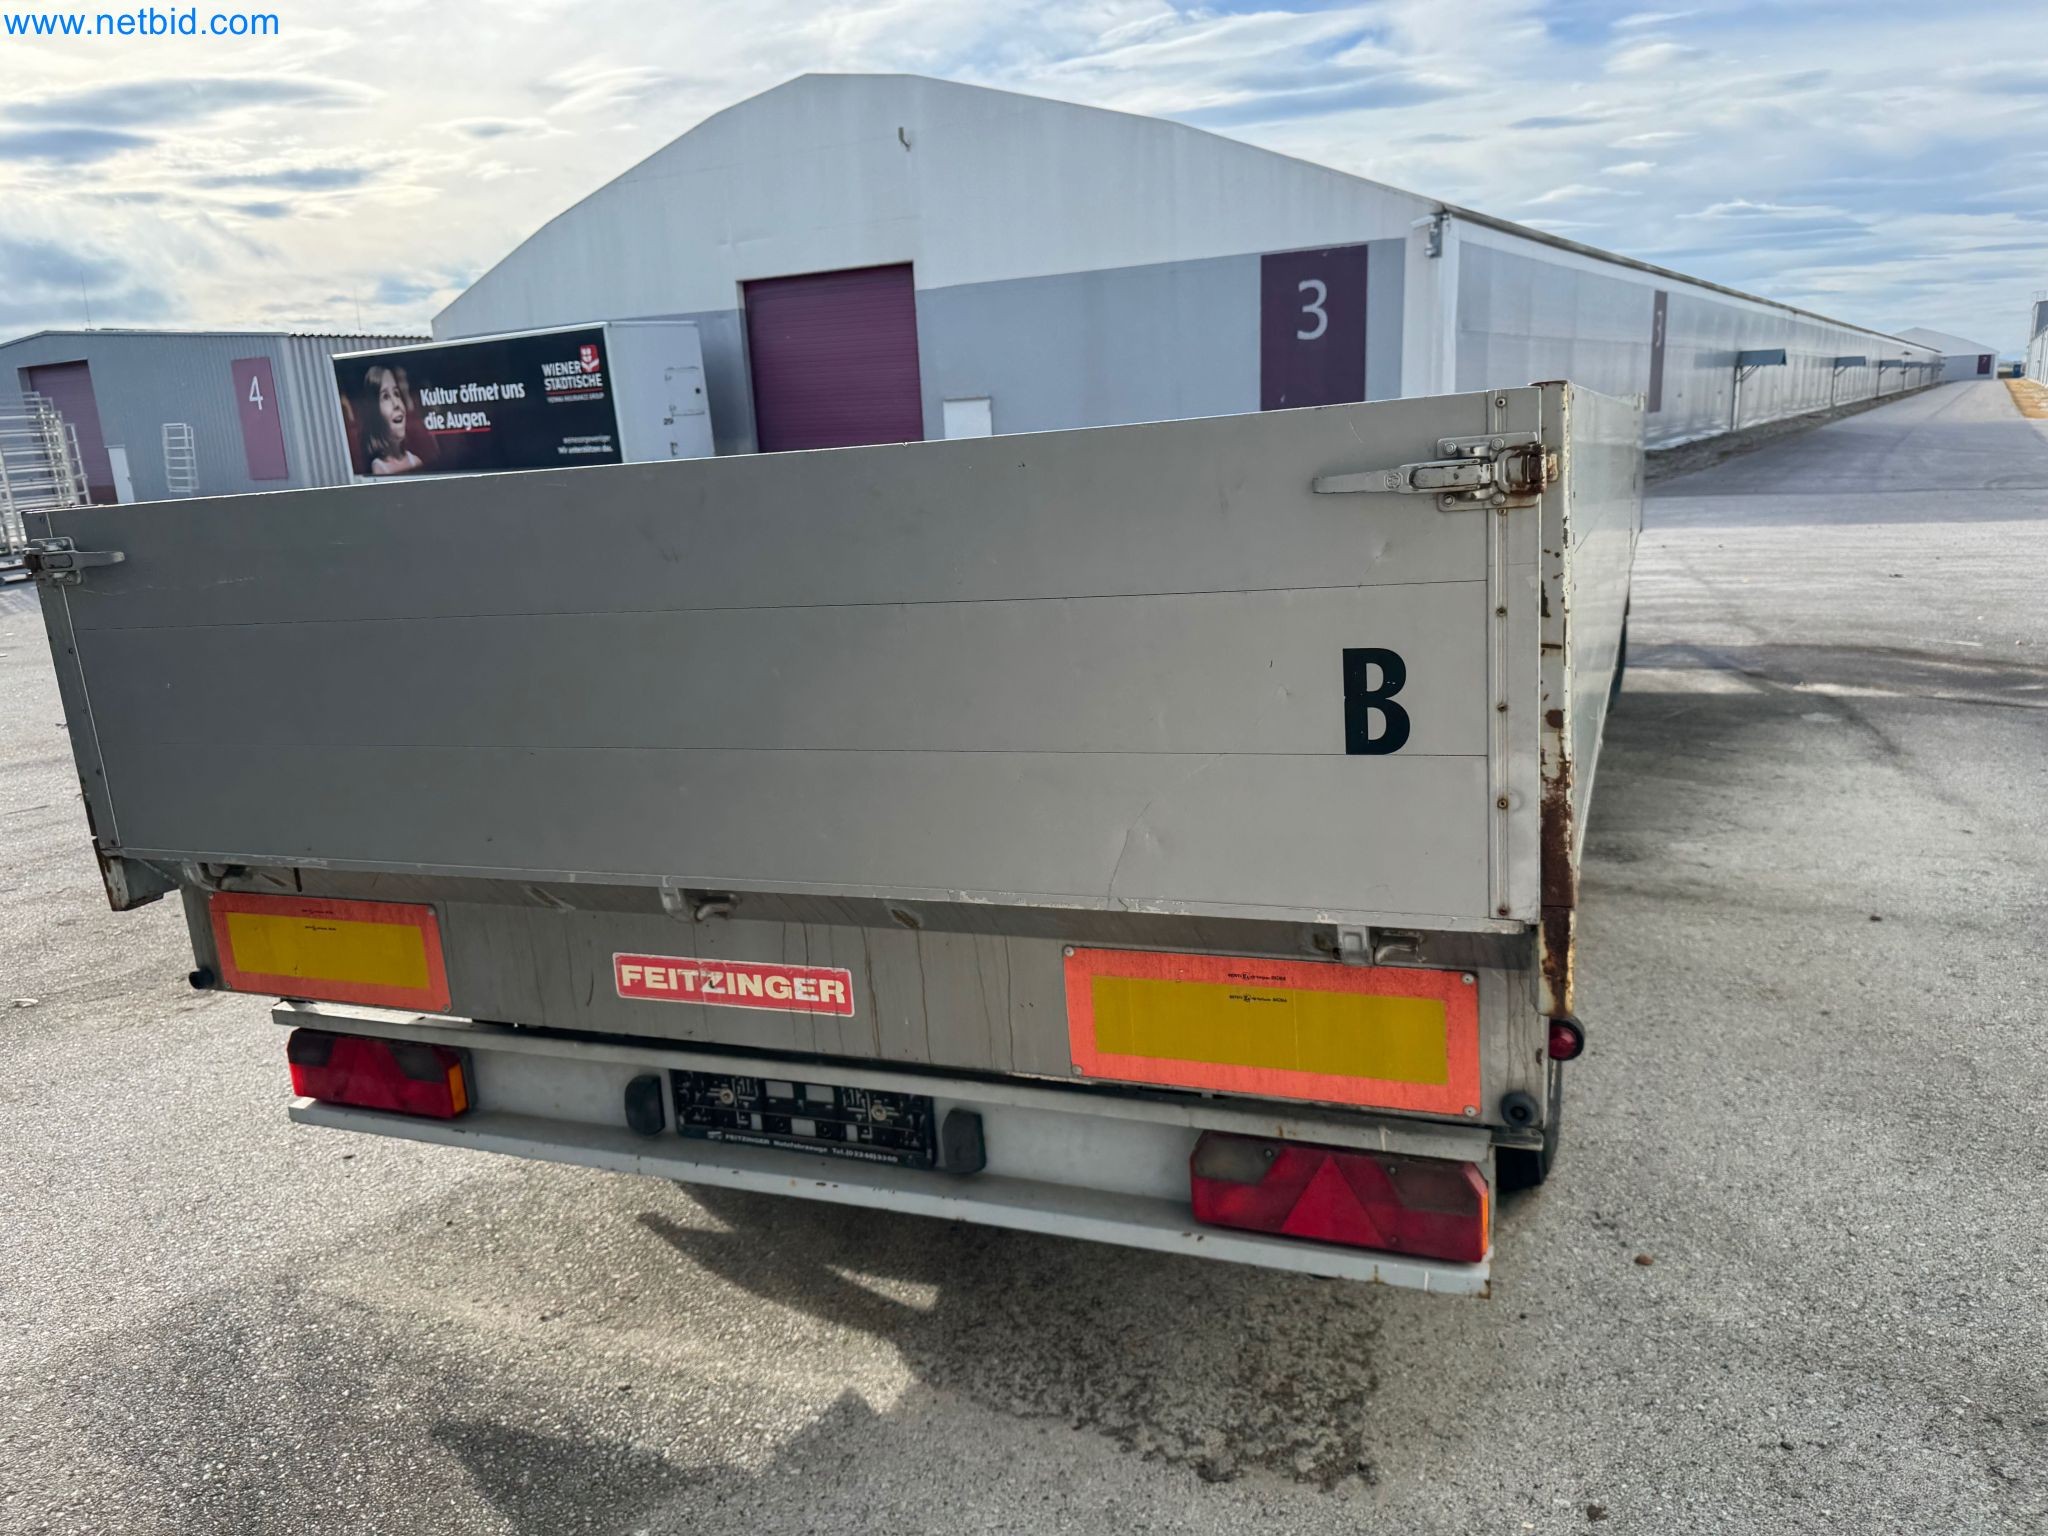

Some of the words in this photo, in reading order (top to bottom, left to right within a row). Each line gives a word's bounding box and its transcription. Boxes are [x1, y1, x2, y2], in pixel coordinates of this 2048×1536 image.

[1297, 278, 1328, 340] 3
[541, 360, 582, 377] WIENER
[249, 375, 263, 410] 4
[420, 387, 458, 406] Kultur
[460, 382, 499, 403] öffnet
[501, 383, 525, 399] uns
[424, 411, 444, 430] die
[446, 411, 491, 431] Augen.
[1342, 648, 1410, 755] B
[620, 964, 845, 1004] FEITZINGER
